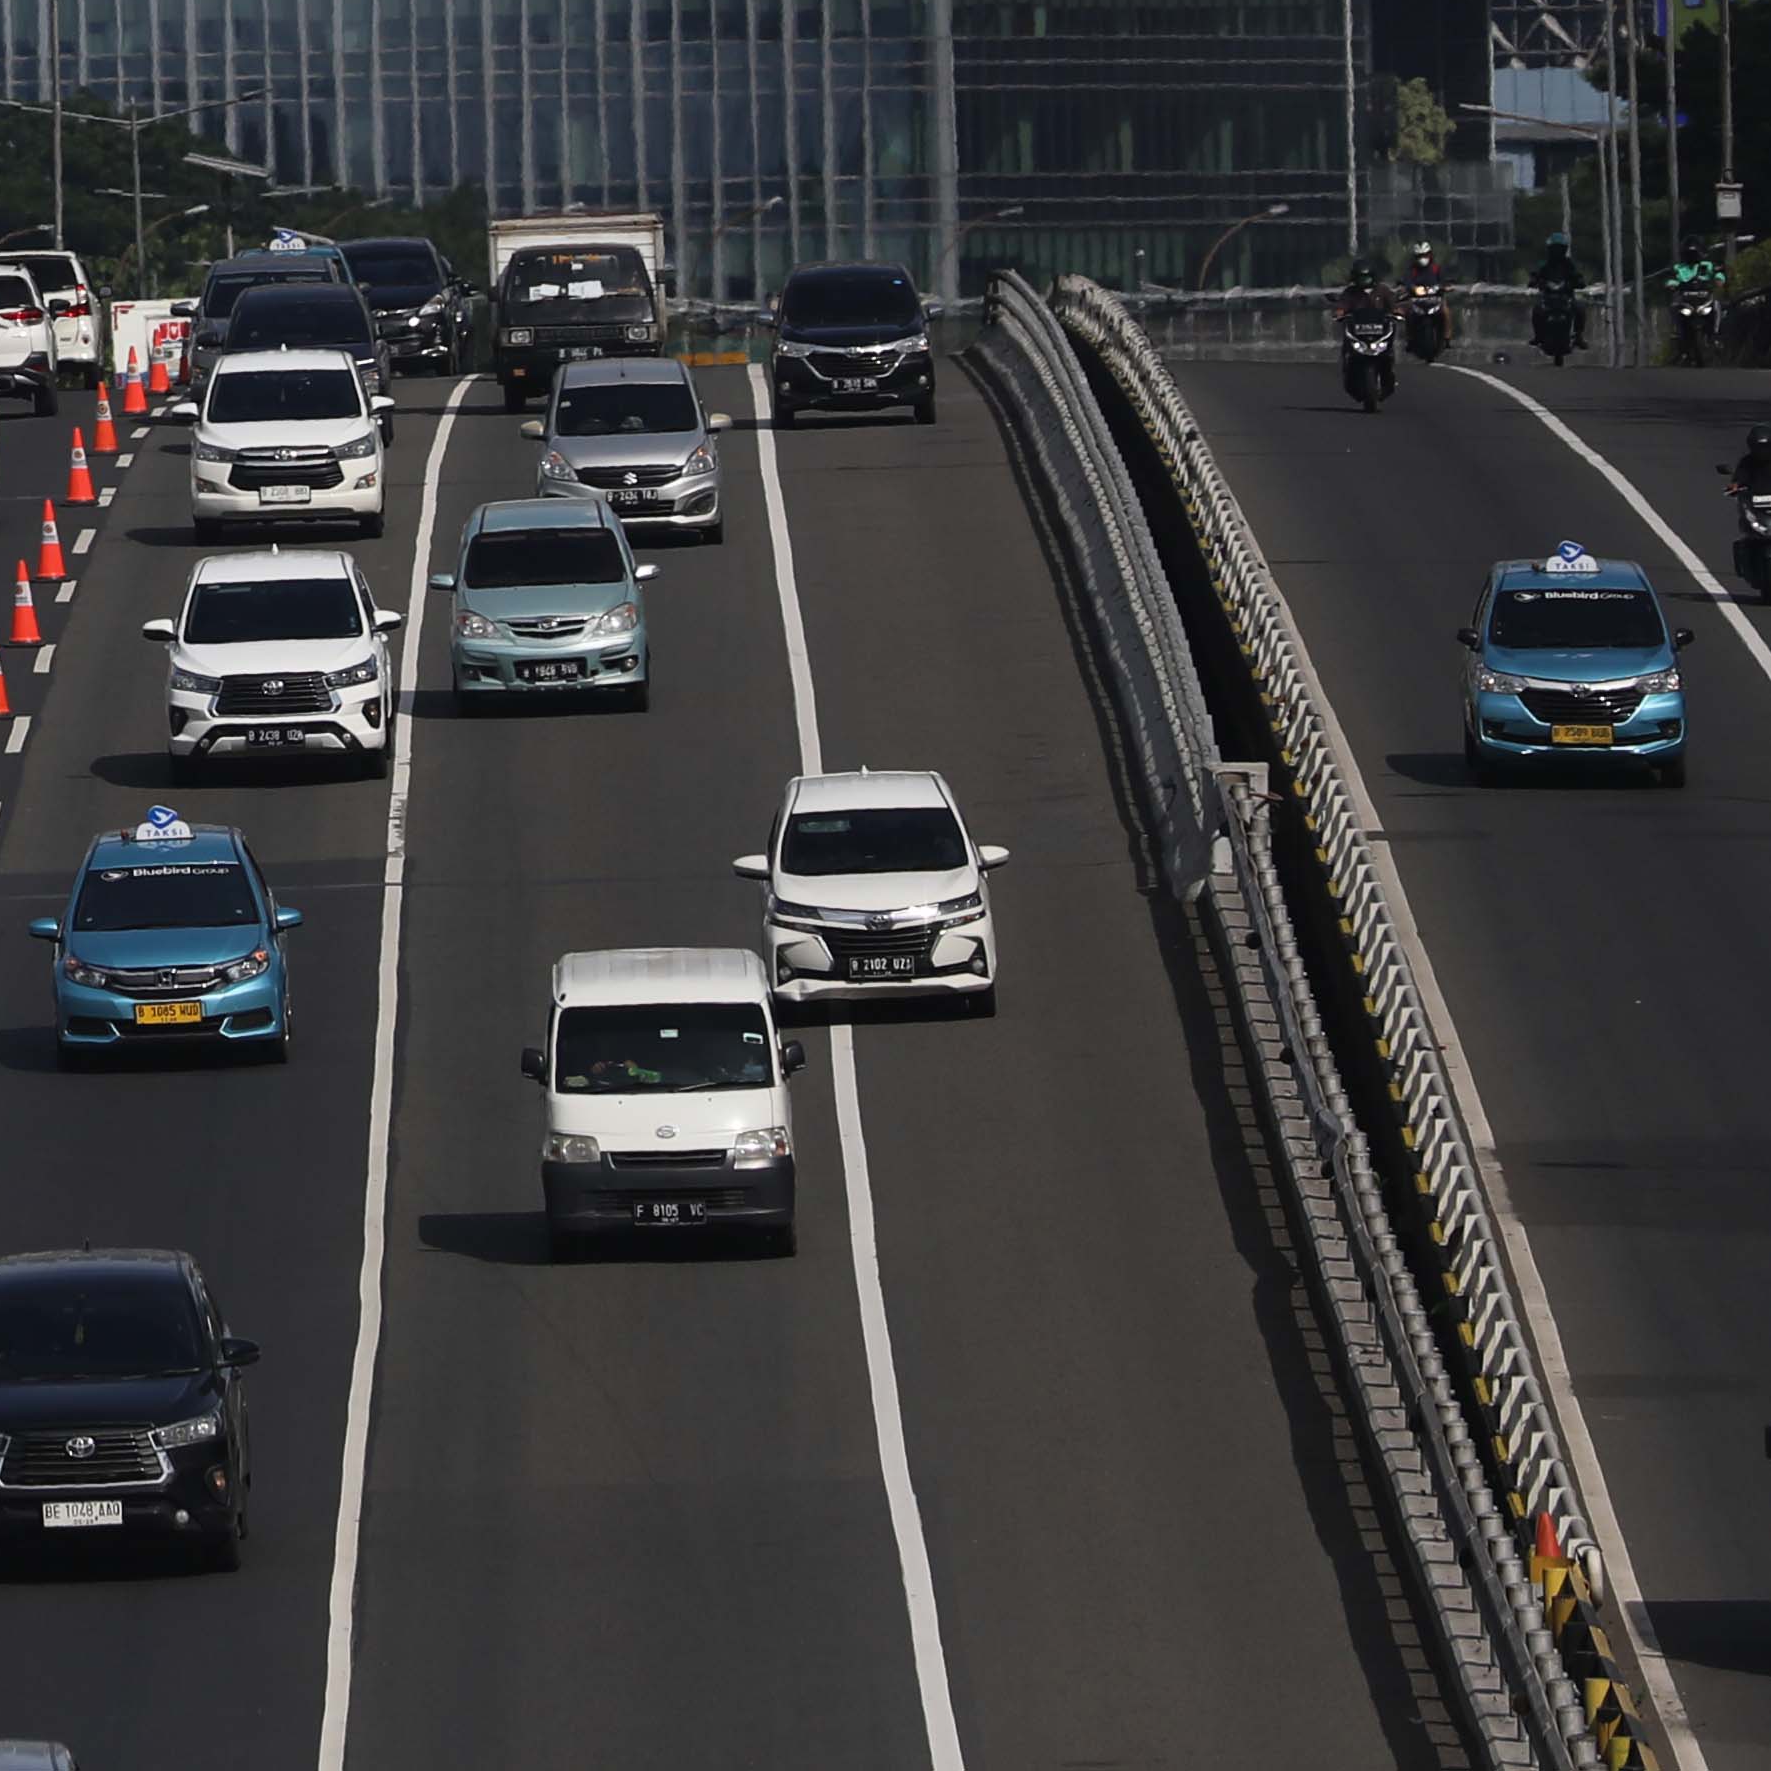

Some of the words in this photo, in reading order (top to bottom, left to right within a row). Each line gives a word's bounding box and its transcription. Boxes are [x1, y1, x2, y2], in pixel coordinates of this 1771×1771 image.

[1544, 590, 1599, 600] Bluebird
[146, 827, 183, 838] TAKSI
[133, 867, 191, 878] Bluebird
[636, 1204, 644, 1218] F
[653, 1203, 679, 1217] 8105
[690, 1203, 704, 1216] VC
[44, 1505, 61, 1519] BE
